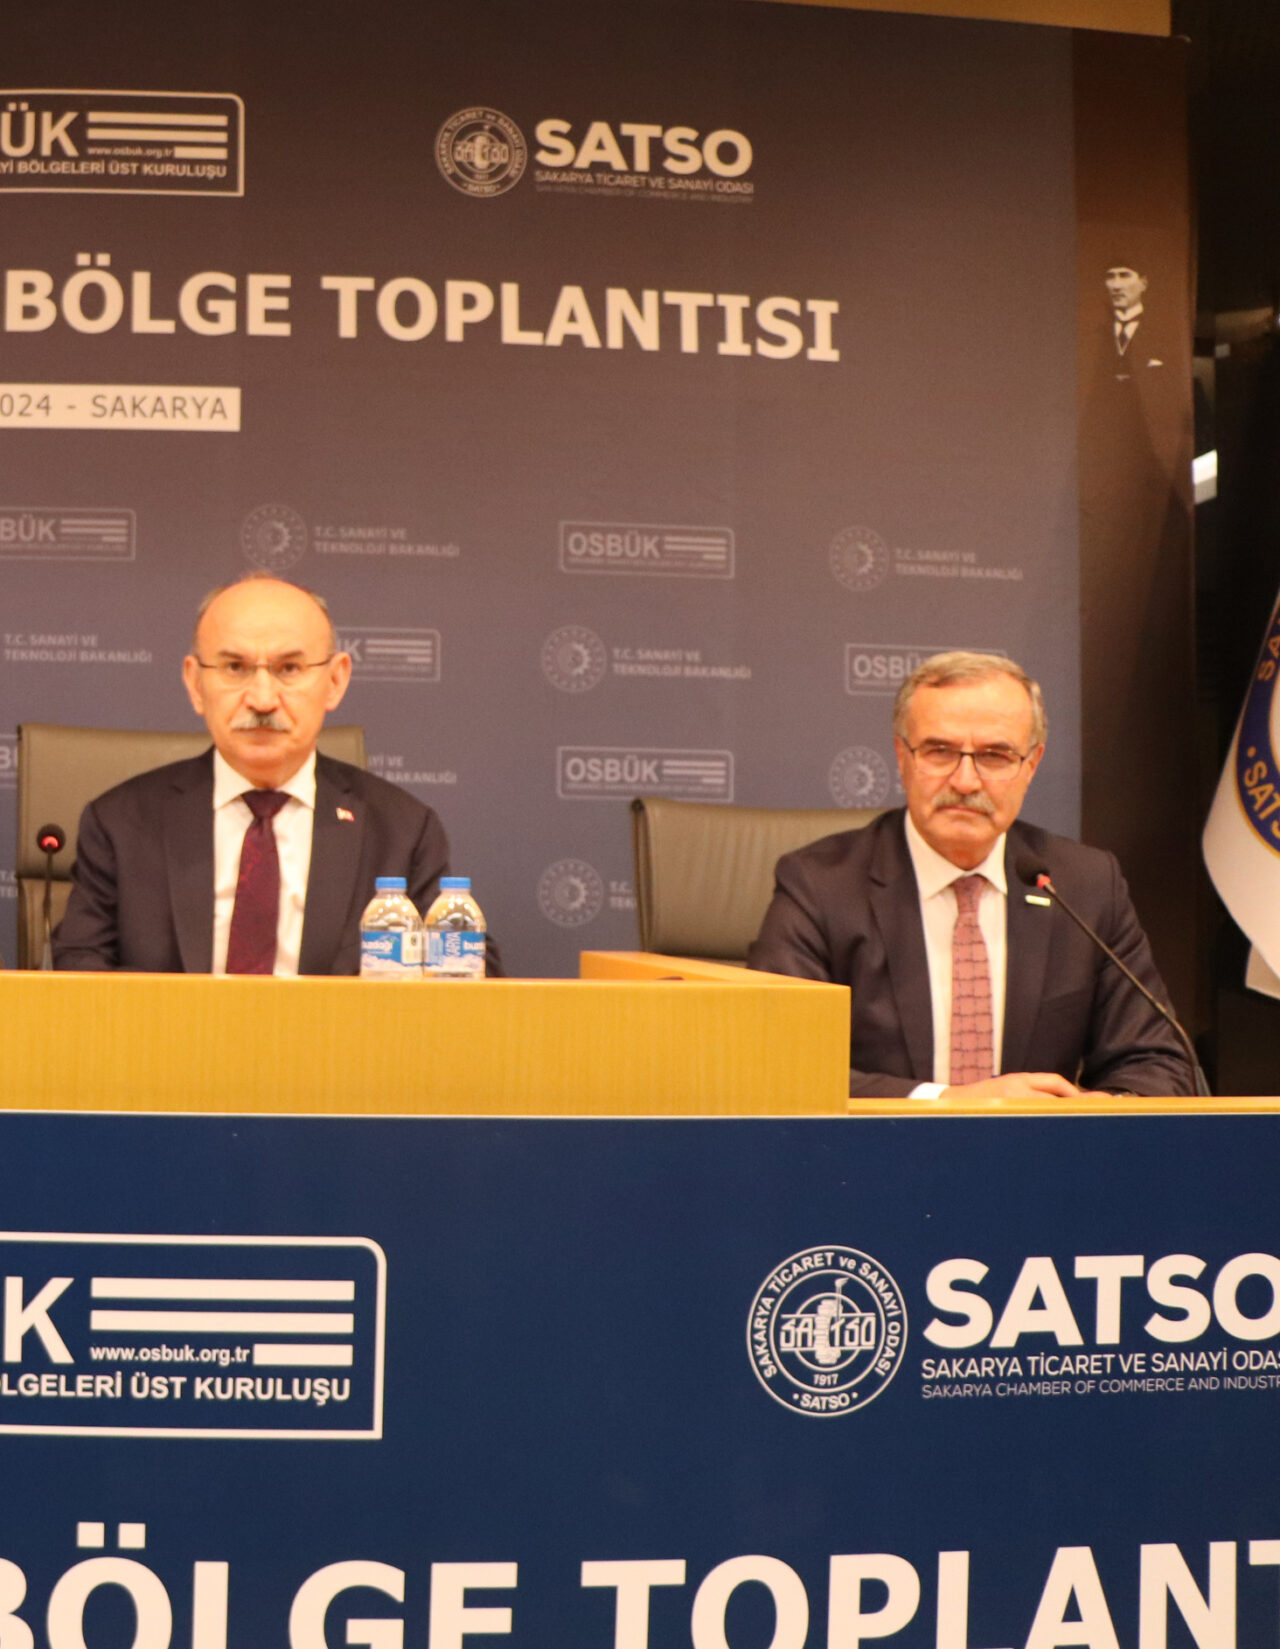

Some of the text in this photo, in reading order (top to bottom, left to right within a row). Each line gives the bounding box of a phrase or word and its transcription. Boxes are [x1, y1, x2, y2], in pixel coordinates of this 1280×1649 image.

[535, 119, 753, 177] SATSO
[18, 160, 105, 175] BÖLGELERİ
[110, 161, 139, 175] ÜST
[142, 164, 227, 180] KURULUŞU
[4, 252, 292, 337] BÖLGE
[322, 273, 841, 362] TOPLANTISI
[91, 394, 229, 421] SAKARYA
[568, 530, 660, 559] OSBÜK
[854, 652, 921, 678] OSBÜ
[566, 754, 660, 783] OSBÜK
[753, 1252, 902, 1378] SAKARYA TİCARET ve SANAYİ ODASI
[922, 1252, 1280, 1349] SATSO
[90, 1344, 250, 1366] www.osbuk.org.tr
[922, 1358, 1023, 1380] SAKARYA
[1027, 1352, 1115, 1377] TİCARET
[1118, 1353, 1146, 1373] VE
[1151, 1347, 1227, 1372] SANAYİ
[131, 1372, 187, 1399] ÜST
[194, 1377, 351, 1406] KURULUŞU
[813, 1373, 839, 1386] 1917
[922, 1383, 993, 1399] SAKARYA
[996, 1381, 1071, 1397] CHAMBER
[1074, 1380, 1096, 1394] OF
[1099, 1378, 1184, 1394] COMMERCE
[1188, 1377, 1220, 1391] AND
[800, 1392, 851, 1411] SATSO
